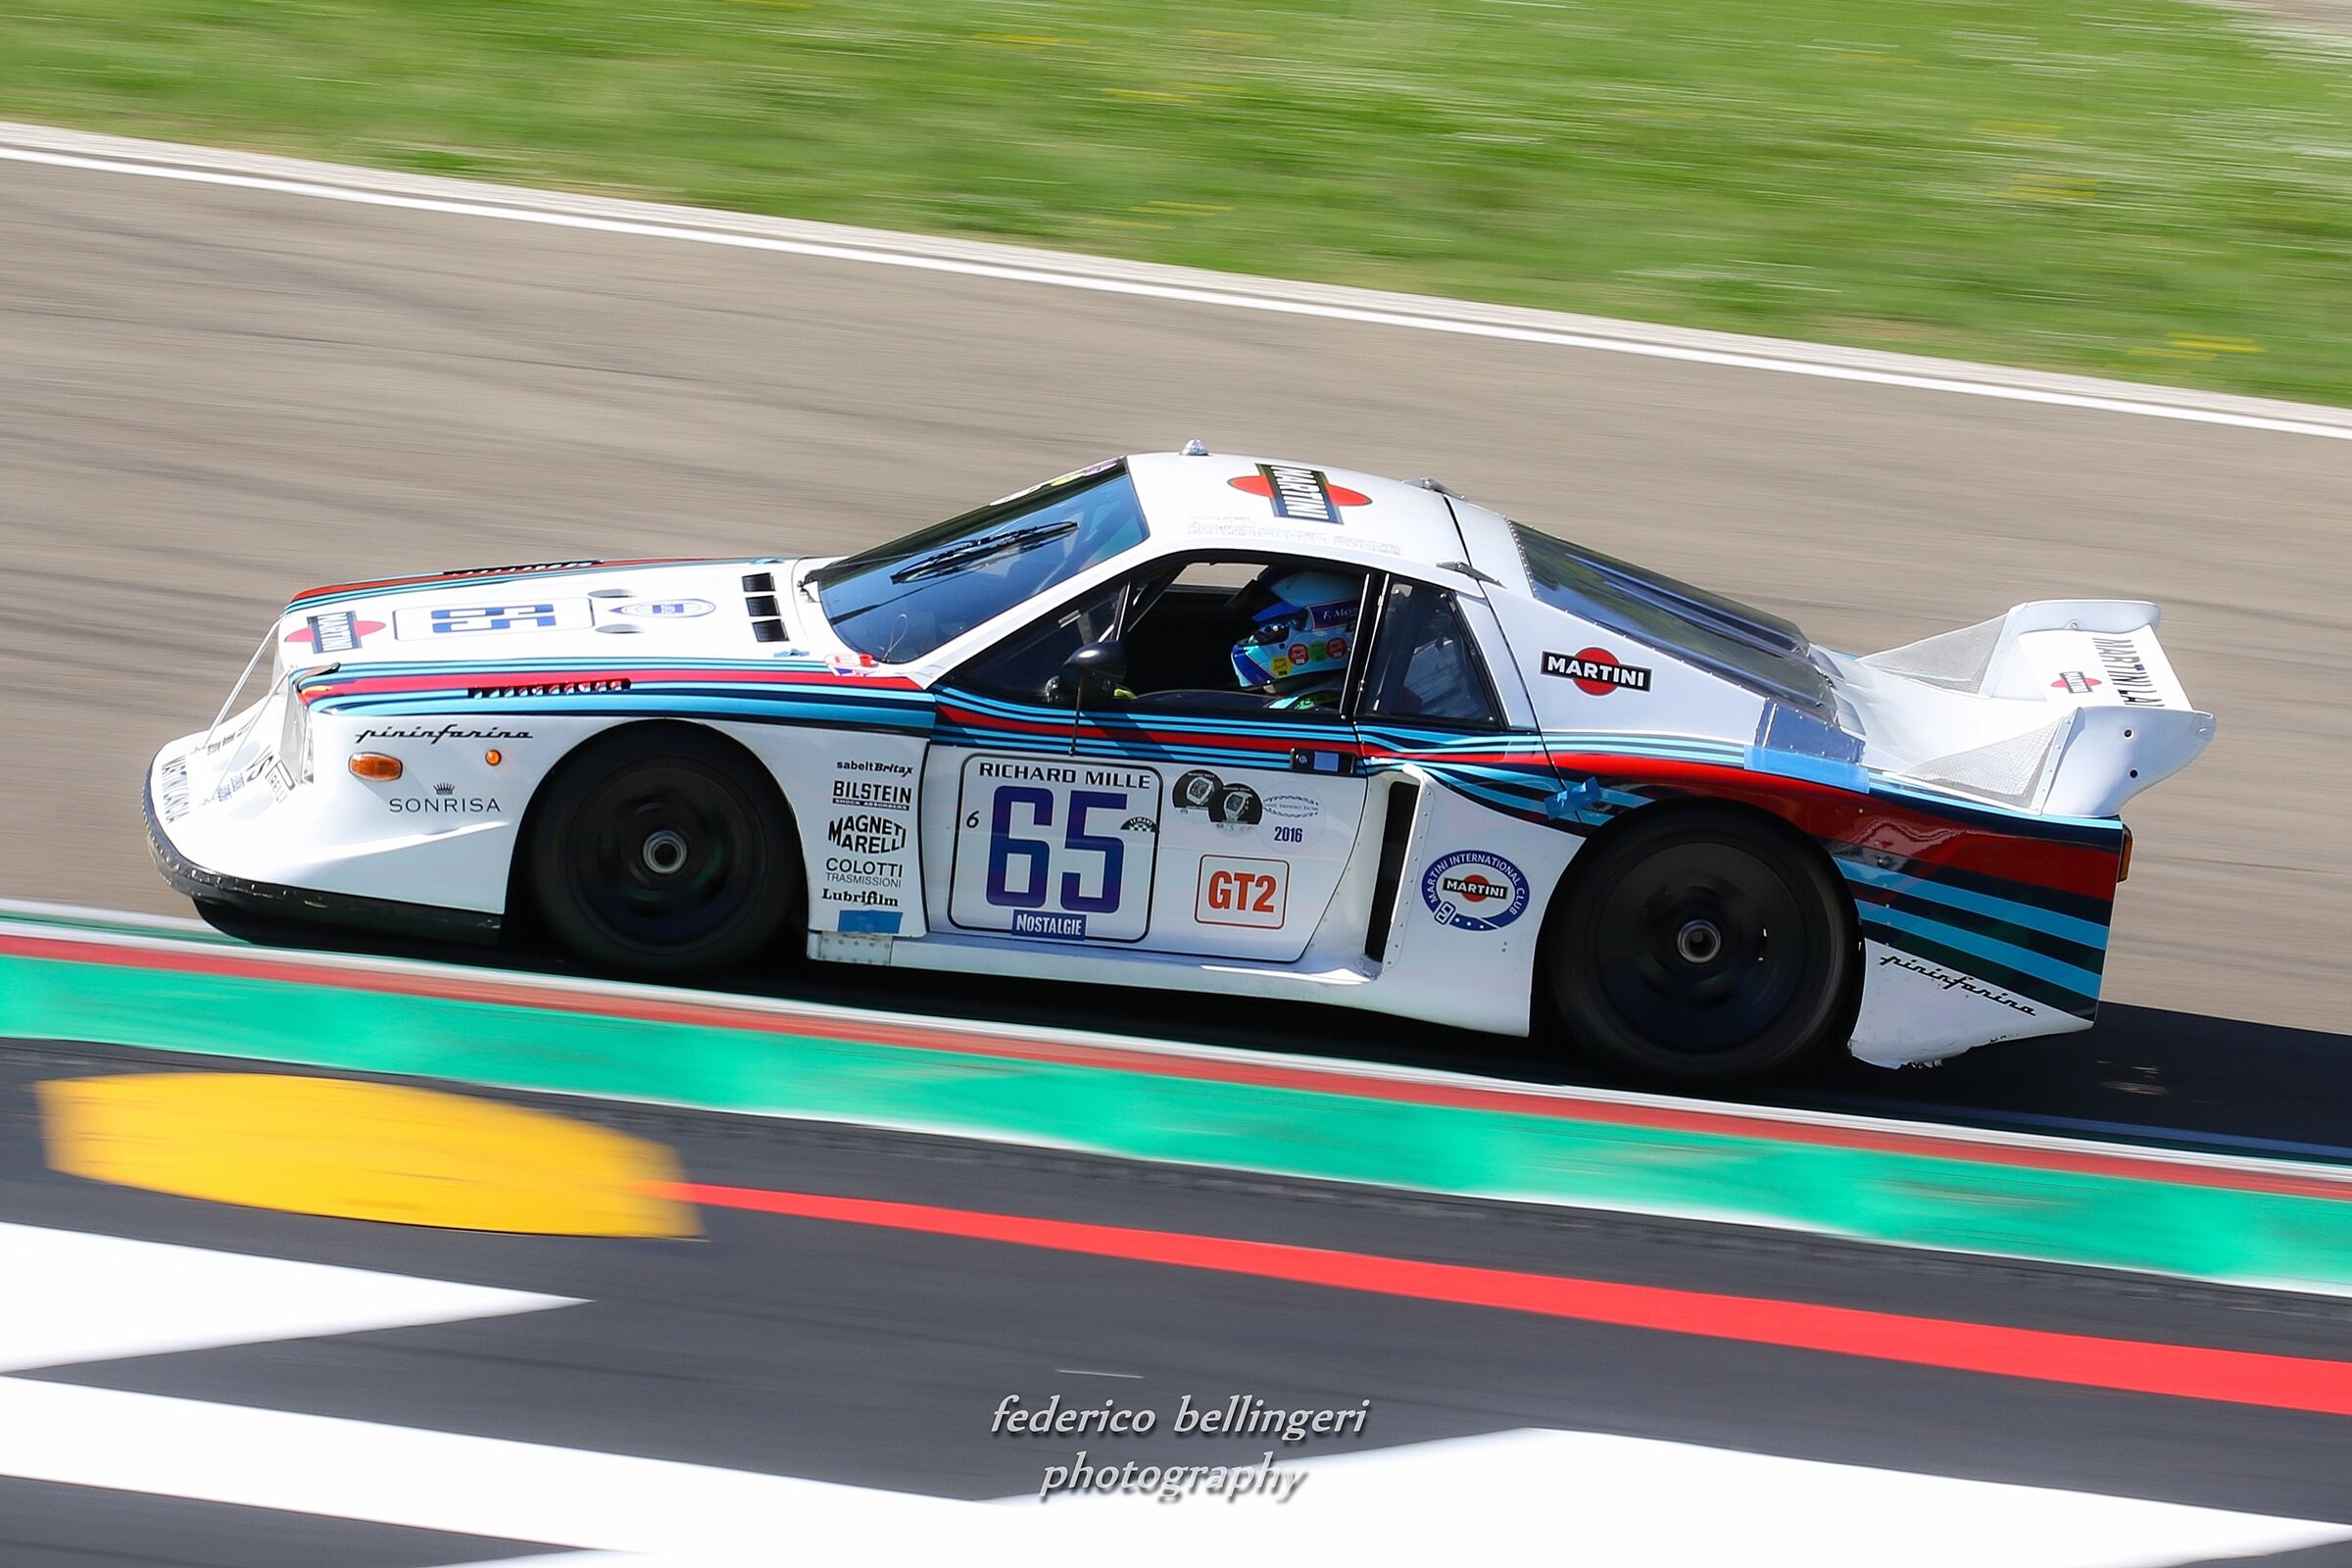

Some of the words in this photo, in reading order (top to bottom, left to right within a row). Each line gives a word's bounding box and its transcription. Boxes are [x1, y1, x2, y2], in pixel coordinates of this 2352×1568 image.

[1270, 465, 1330, 520] MARTINI
[318, 612, 354, 652] MARTINI
[1547, 656, 1644, 687] MARTINI
[2091, 637, 2154, 687] MARTINI
[355, 723, 534, 745] pininfarina
[265, 760, 297, 806] PIRELLI
[836, 760, 873, 772] sabelt
[874, 762, 913, 778] Britax
[979, 762, 1076, 784] RICHARD
[1085, 771, 1152, 790] MILLE
[389, 798, 502, 813] SONRISA
[833, 780, 911, 805] BILSTEIN
[828, 814, 906, 845] MAGNETI
[966, 810, 980, 828] 6
[828, 823, 906, 854] MARELLI
[1273, 826, 1303, 843] 2016
[986, 785, 1128, 914] 65
[826, 858, 904, 878] COLOTTI
[826, 872, 902, 888] TRASMISSIONI
[822, 888, 899, 907] Lubrifilm
[1208, 870, 1277, 913] GT2
[1427, 859, 1449, 904] MARTINI
[1449, 853, 1521, 886] INTERNATIONAL
[1509, 887, 1526, 915] CLUB
[1446, 880, 1504, 898] MARTINI
[1015, 913, 1083, 936] NOSTALGIE
[1879, 955, 2036, 1016] pininfarina
